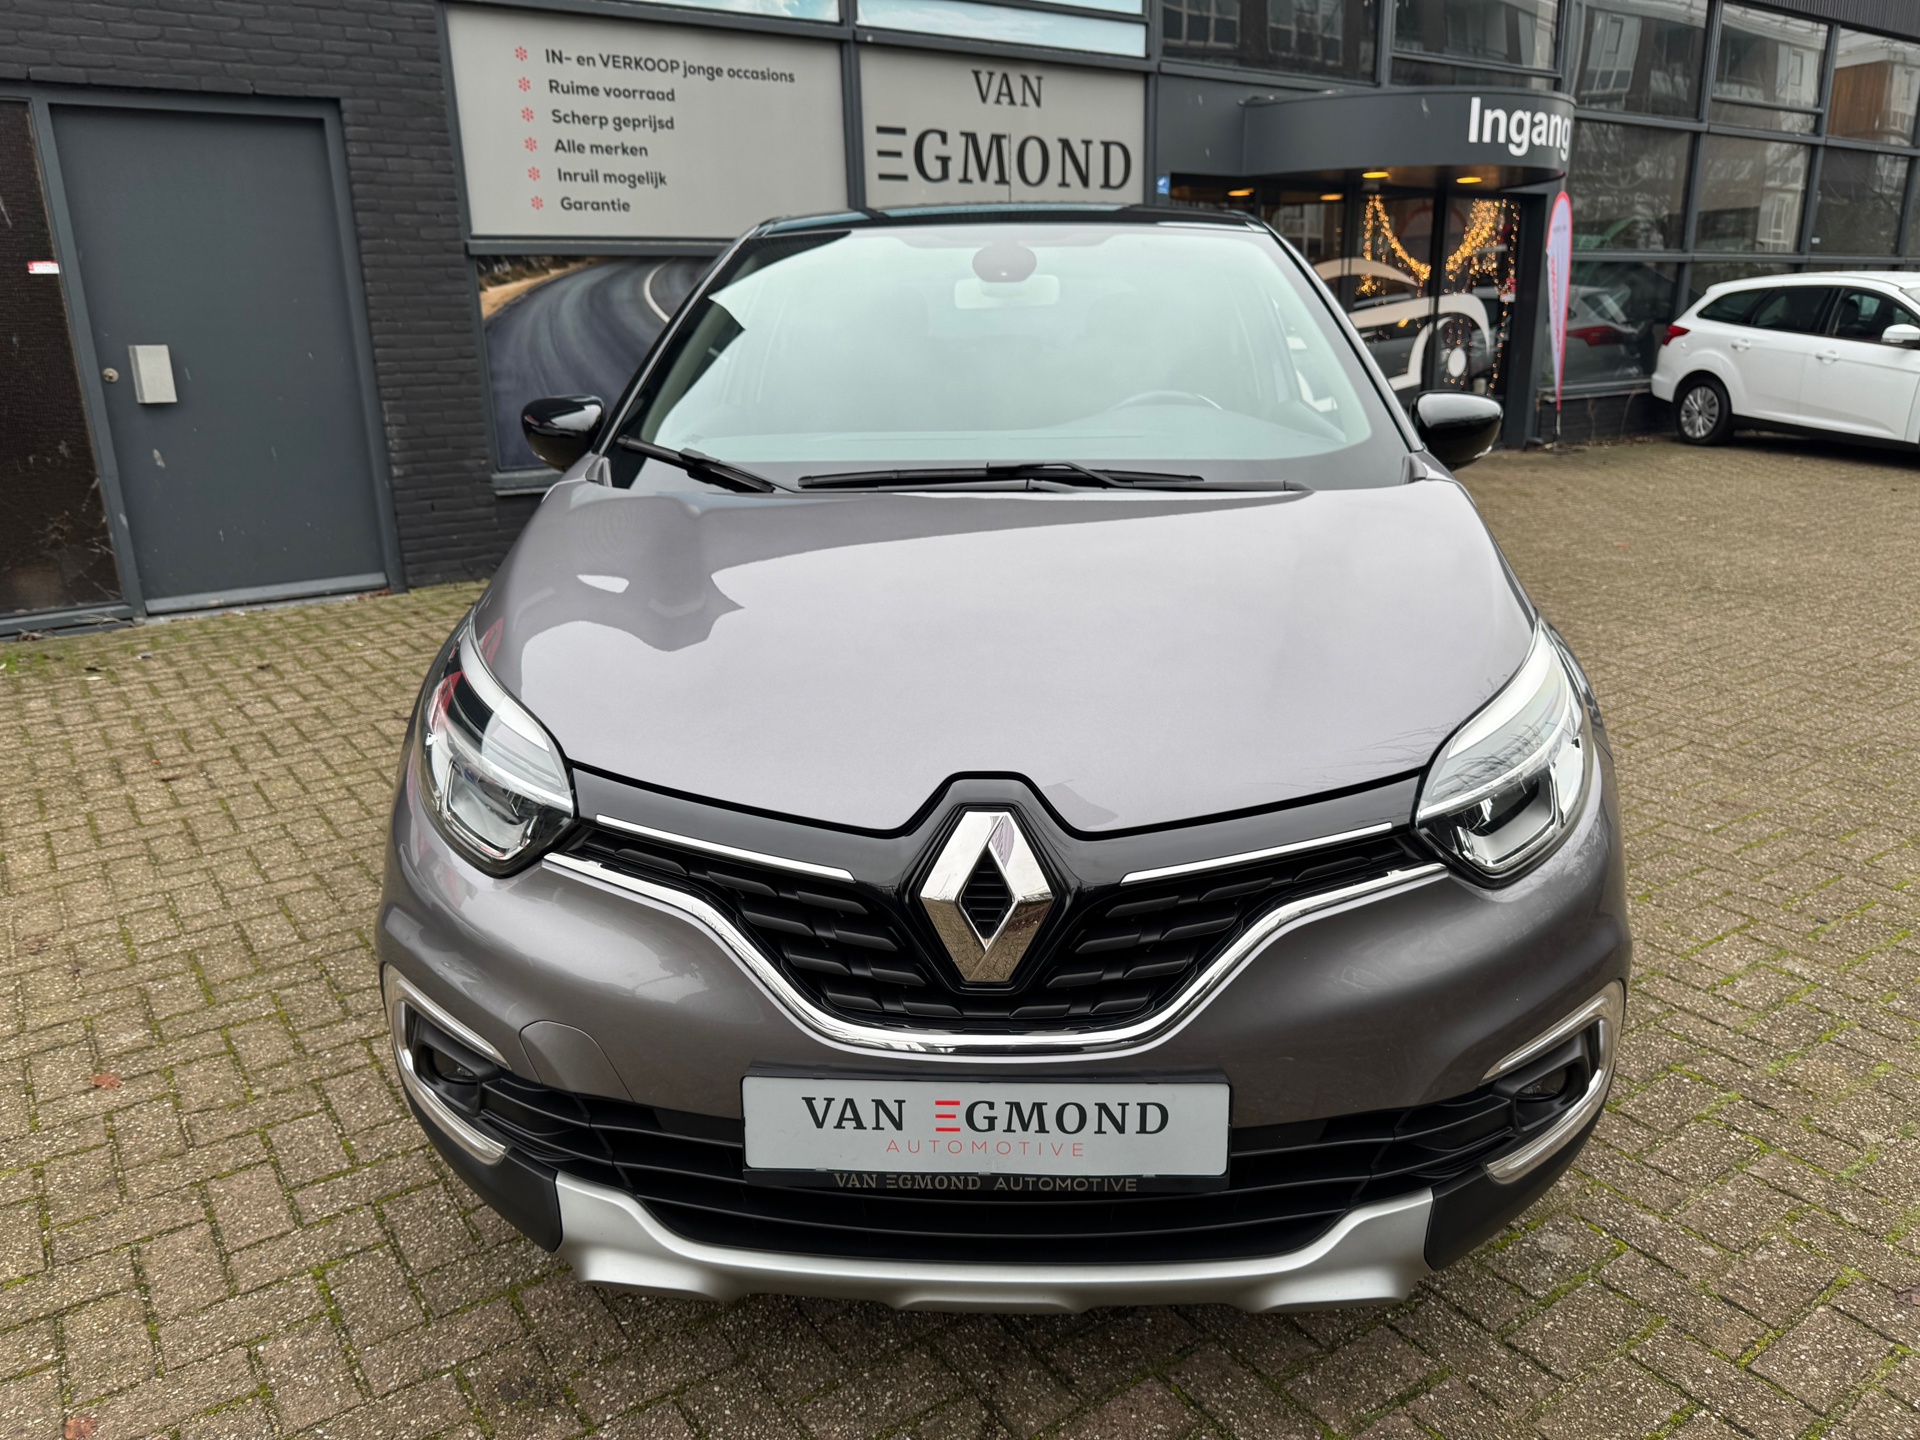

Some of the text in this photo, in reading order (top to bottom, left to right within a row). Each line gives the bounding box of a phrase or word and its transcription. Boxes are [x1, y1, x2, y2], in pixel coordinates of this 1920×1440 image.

[545, 48, 796, 84] IN- en VERKOOP jonge occasions
[548, 79, 676, 102] Ruime voorraad
[971, 69, 1044, 108] VAN
[551, 108, 675, 132] Scherp geprijsd
[1468, 96, 1572, 161] Ingang
[554, 138, 649, 157] Alle merken
[876, 125, 1132, 191] EGMOND
[557, 167, 668, 189] Inruil mogelijk
[560, 196, 631, 213] Garantie
[802, 1096, 1170, 1135] VAN EGMOND
[886, 1139, 1085, 1158] AUTOMOTIVE
[833, 1172, 1138, 1192] VAN EGMOND AUTOMOTIVE
